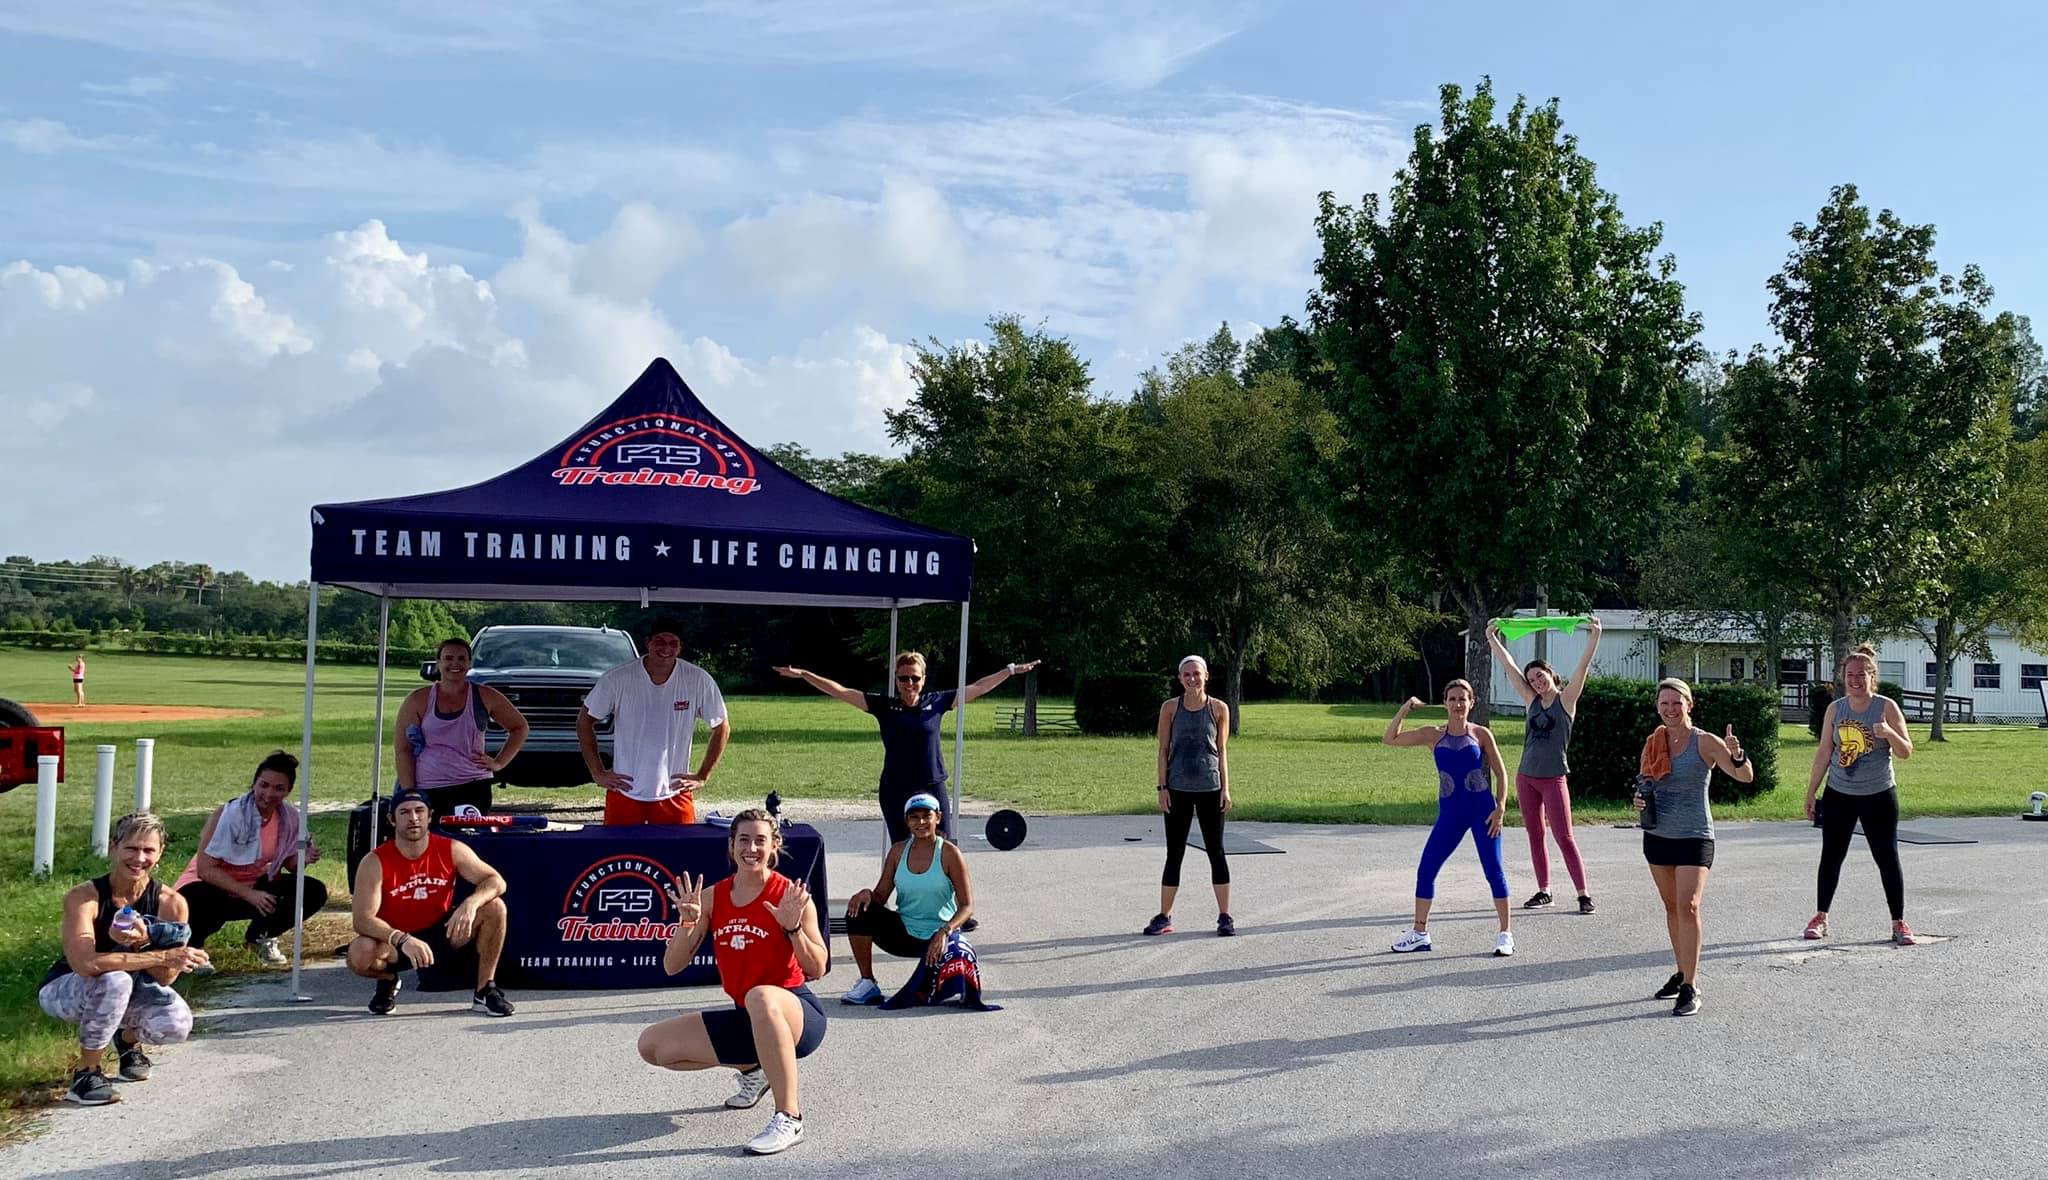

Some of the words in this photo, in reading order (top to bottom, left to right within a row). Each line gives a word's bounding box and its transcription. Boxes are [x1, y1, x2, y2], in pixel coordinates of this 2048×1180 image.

[579, 418, 708, 454] FUNCTIONAL
[716, 442, 737, 459] 45
[617, 444, 701, 466] F45
[551, 466, 761, 496] Training
[351, 529, 441, 557] TEAM
[464, 532, 631, 561] TRAINING
[693, 539, 758, 566] LIFE
[779, 543, 940, 575] CHANGING
[575, 861, 660, 897] FUNCTIONAL
[598, 889, 653, 912] F45
[730, 934, 746, 950] 45
[520, 957, 551, 967] TEAM
[556, 956, 614, 967] TRAINING
[633, 955, 657, 966] LIFE
